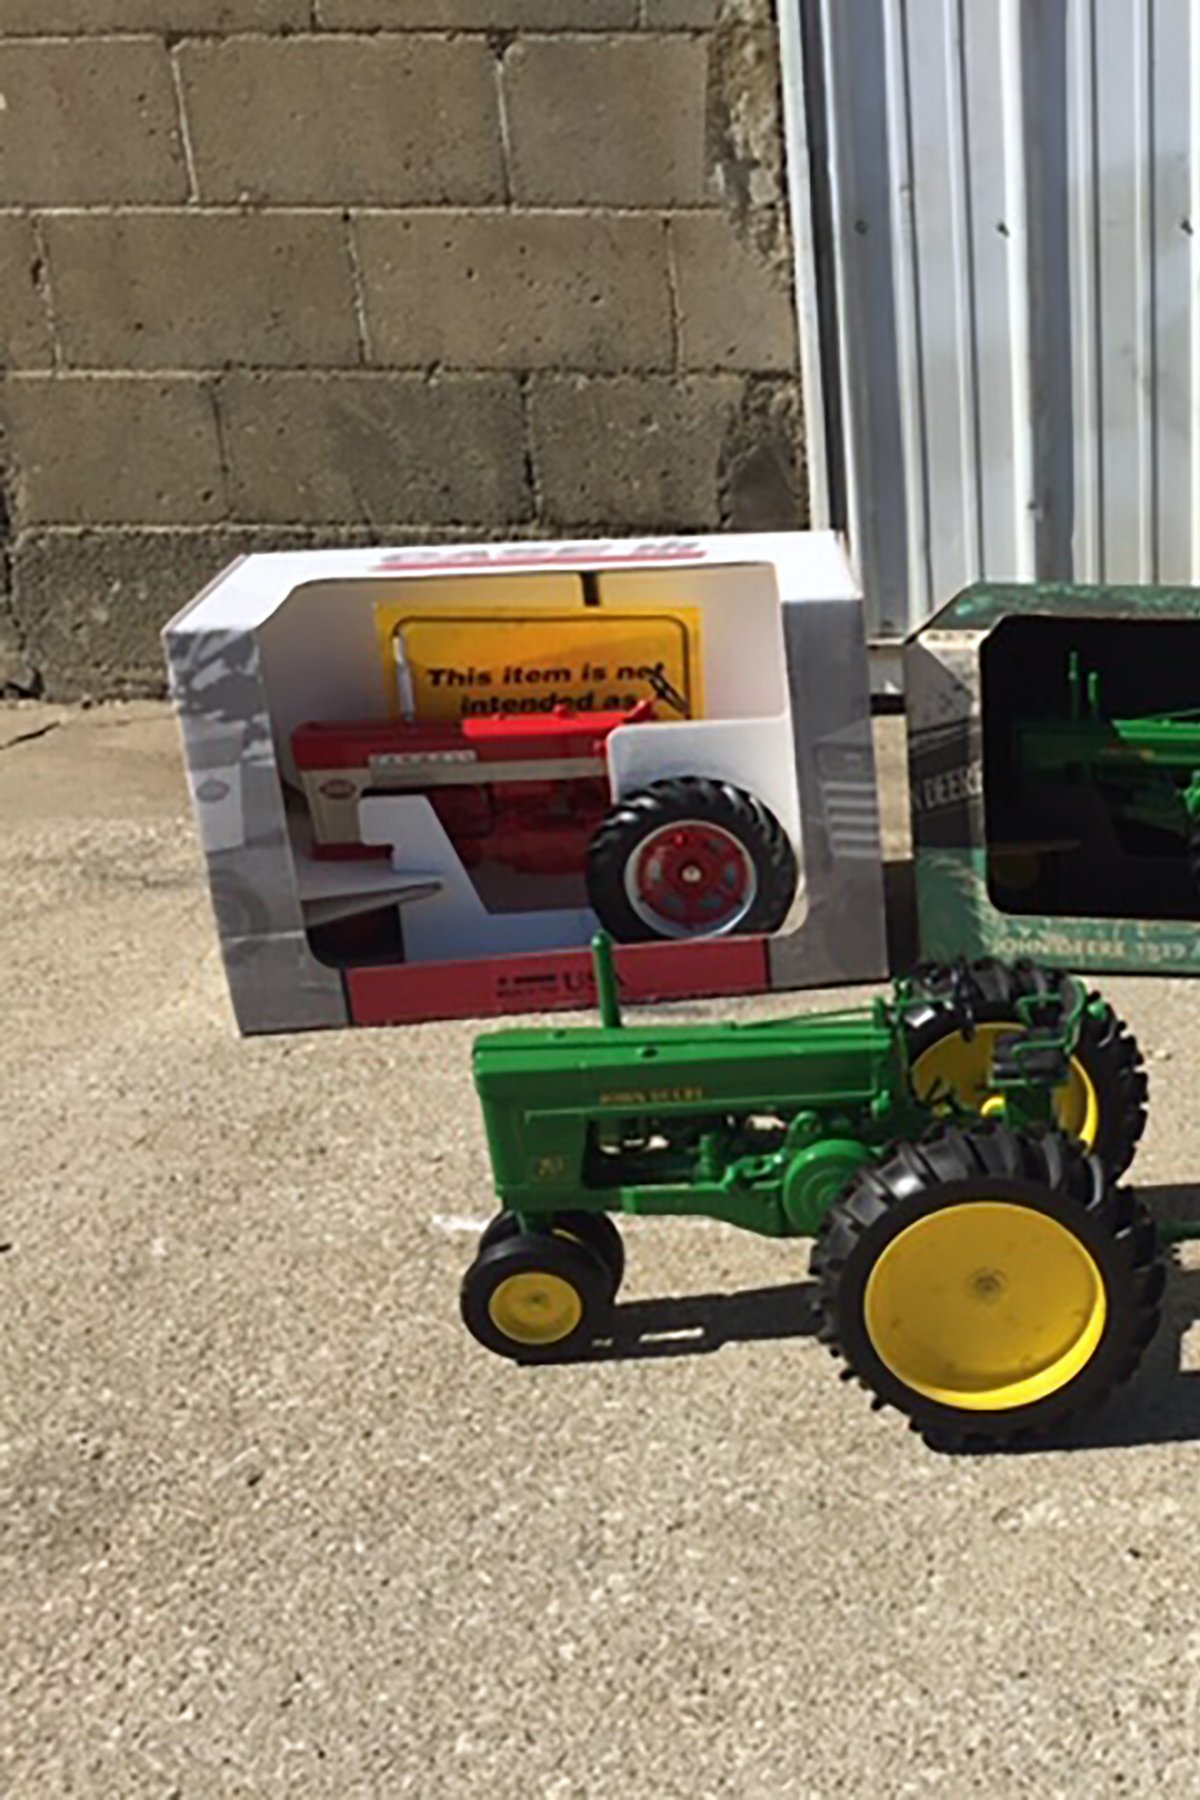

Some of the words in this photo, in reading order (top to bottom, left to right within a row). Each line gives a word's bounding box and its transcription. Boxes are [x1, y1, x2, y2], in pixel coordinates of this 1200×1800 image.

[427, 667, 492, 687] This
[503, 665, 571, 685] item
[582, 662, 608, 682] is
[616, 661, 665, 682] not
[460, 692, 595, 714] intended
